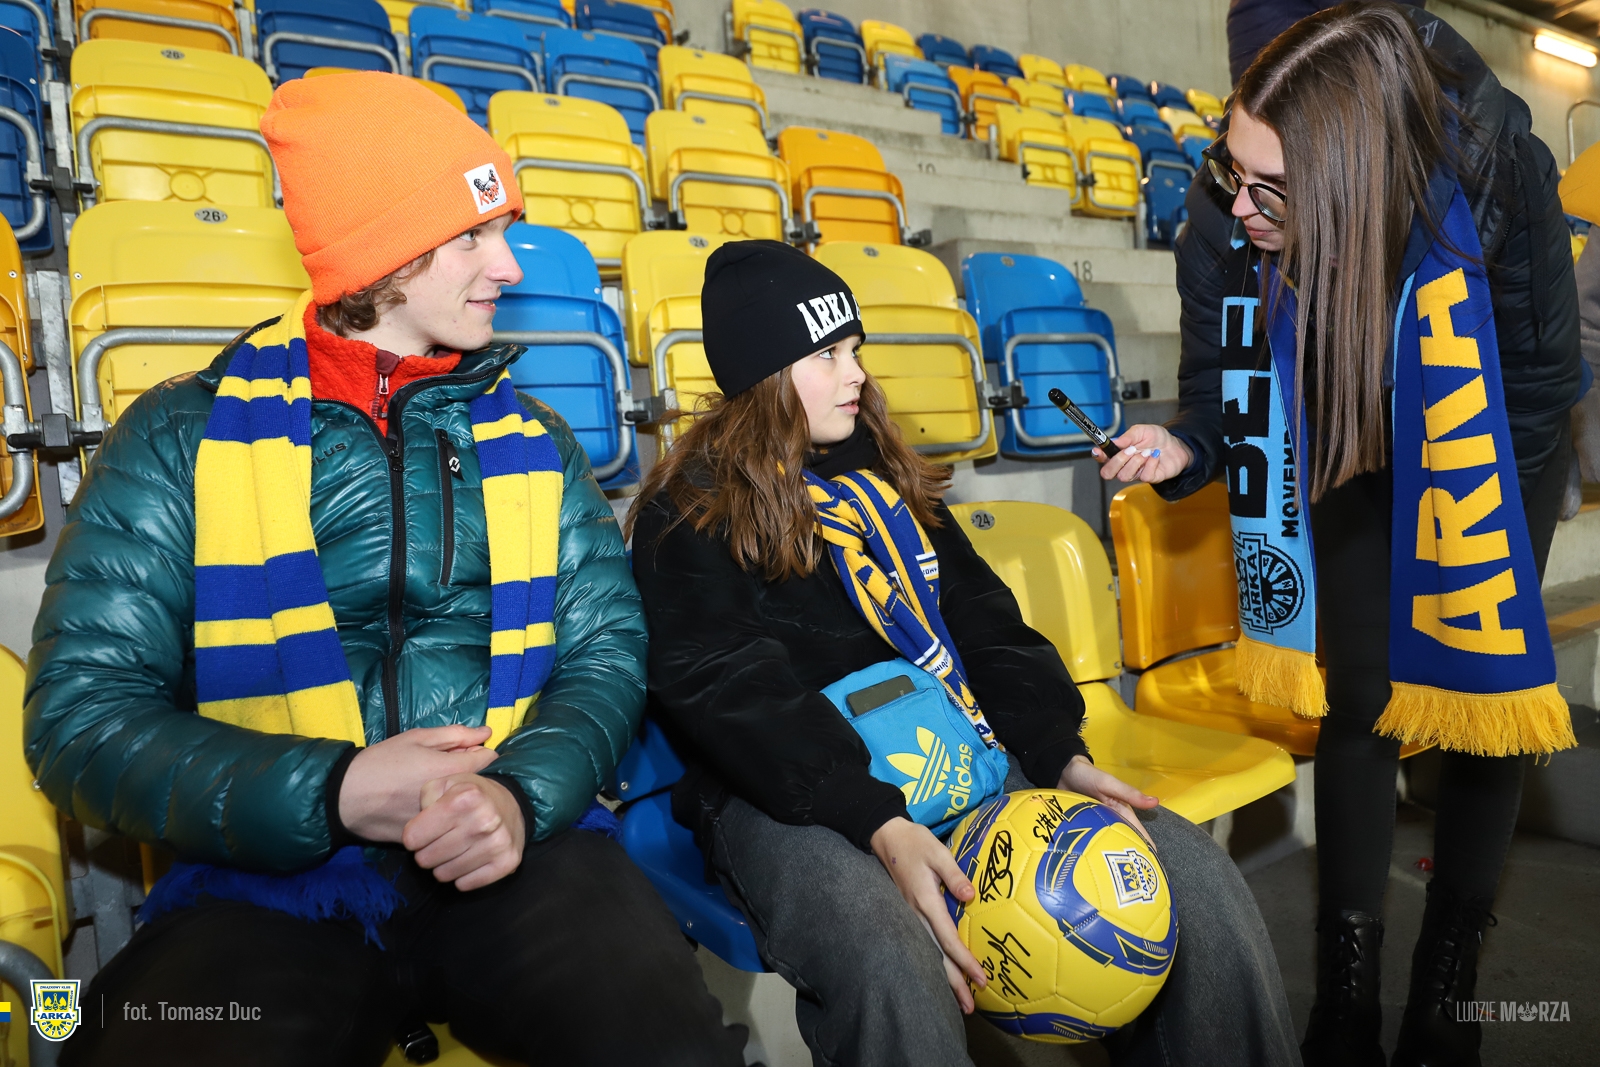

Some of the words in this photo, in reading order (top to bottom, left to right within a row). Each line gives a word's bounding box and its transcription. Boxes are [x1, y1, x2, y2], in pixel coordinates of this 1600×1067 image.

[202, 210, 221, 222] 26
[1073, 260, 1093, 283] 18
[796, 291, 854, 344] ARKA
[975, 513, 991, 528] 24
[1247, 552, 1264, 620] ARKA
[1133, 857, 1149, 893] ARKA
